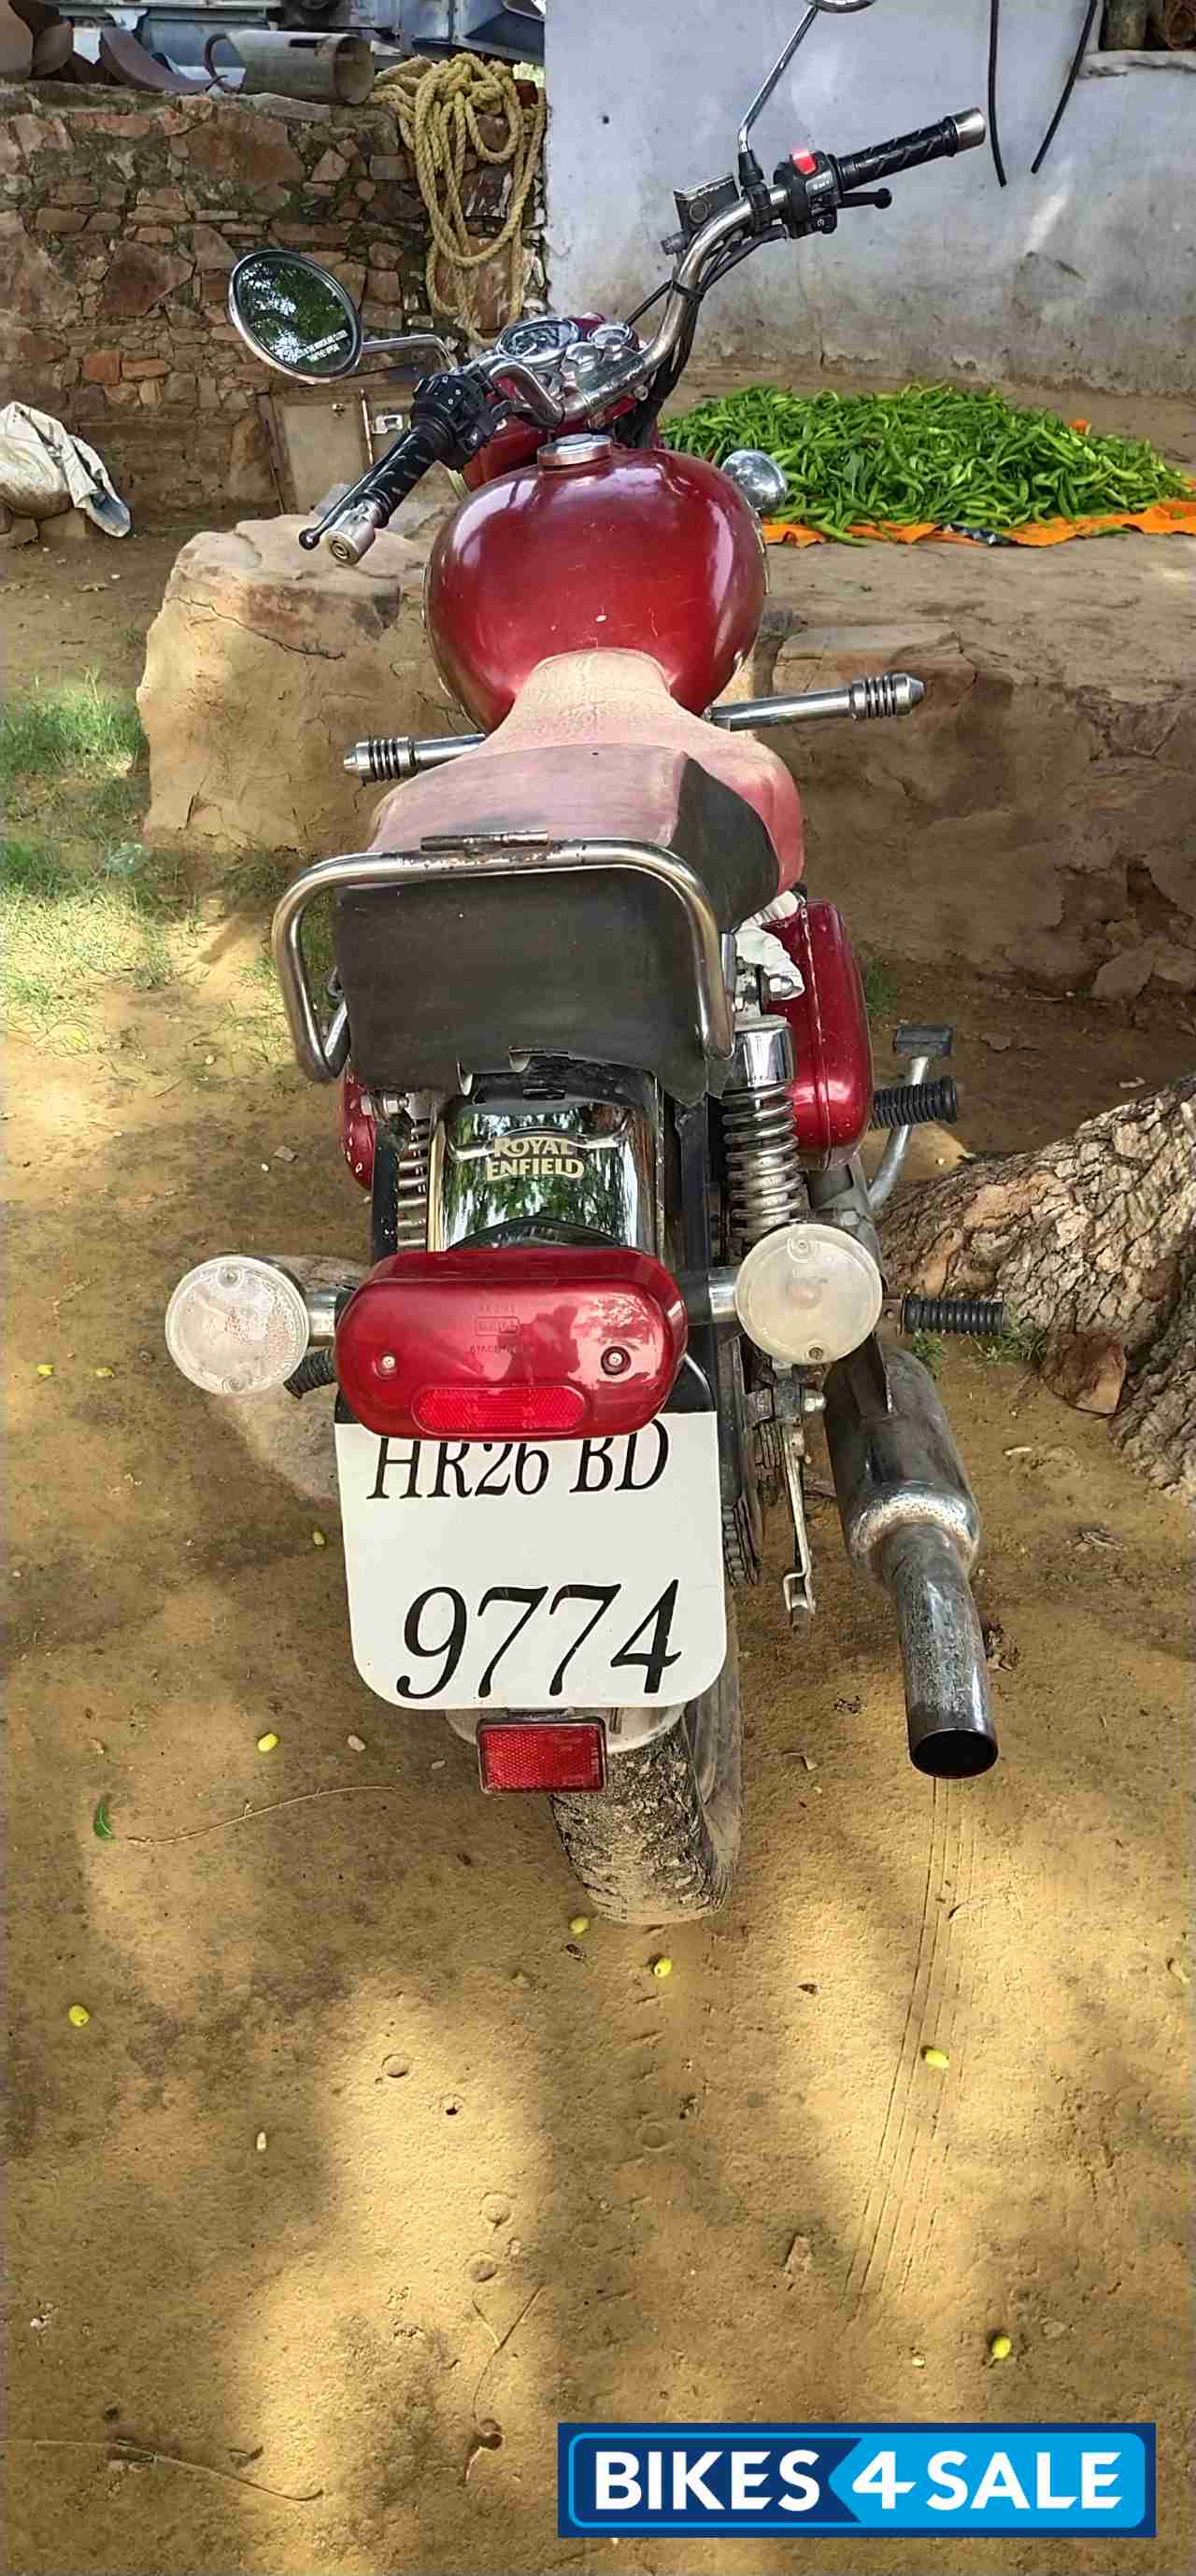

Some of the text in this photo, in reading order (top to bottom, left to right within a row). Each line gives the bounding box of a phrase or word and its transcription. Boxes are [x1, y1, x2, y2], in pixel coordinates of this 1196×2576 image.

[486, 1157, 585, 1182] ENFIELD
[493, 1136, 574, 1157] ROYAL
[365, 1418, 670, 1500] HR26 BD
[395, 1578, 683, 1700] 9774
